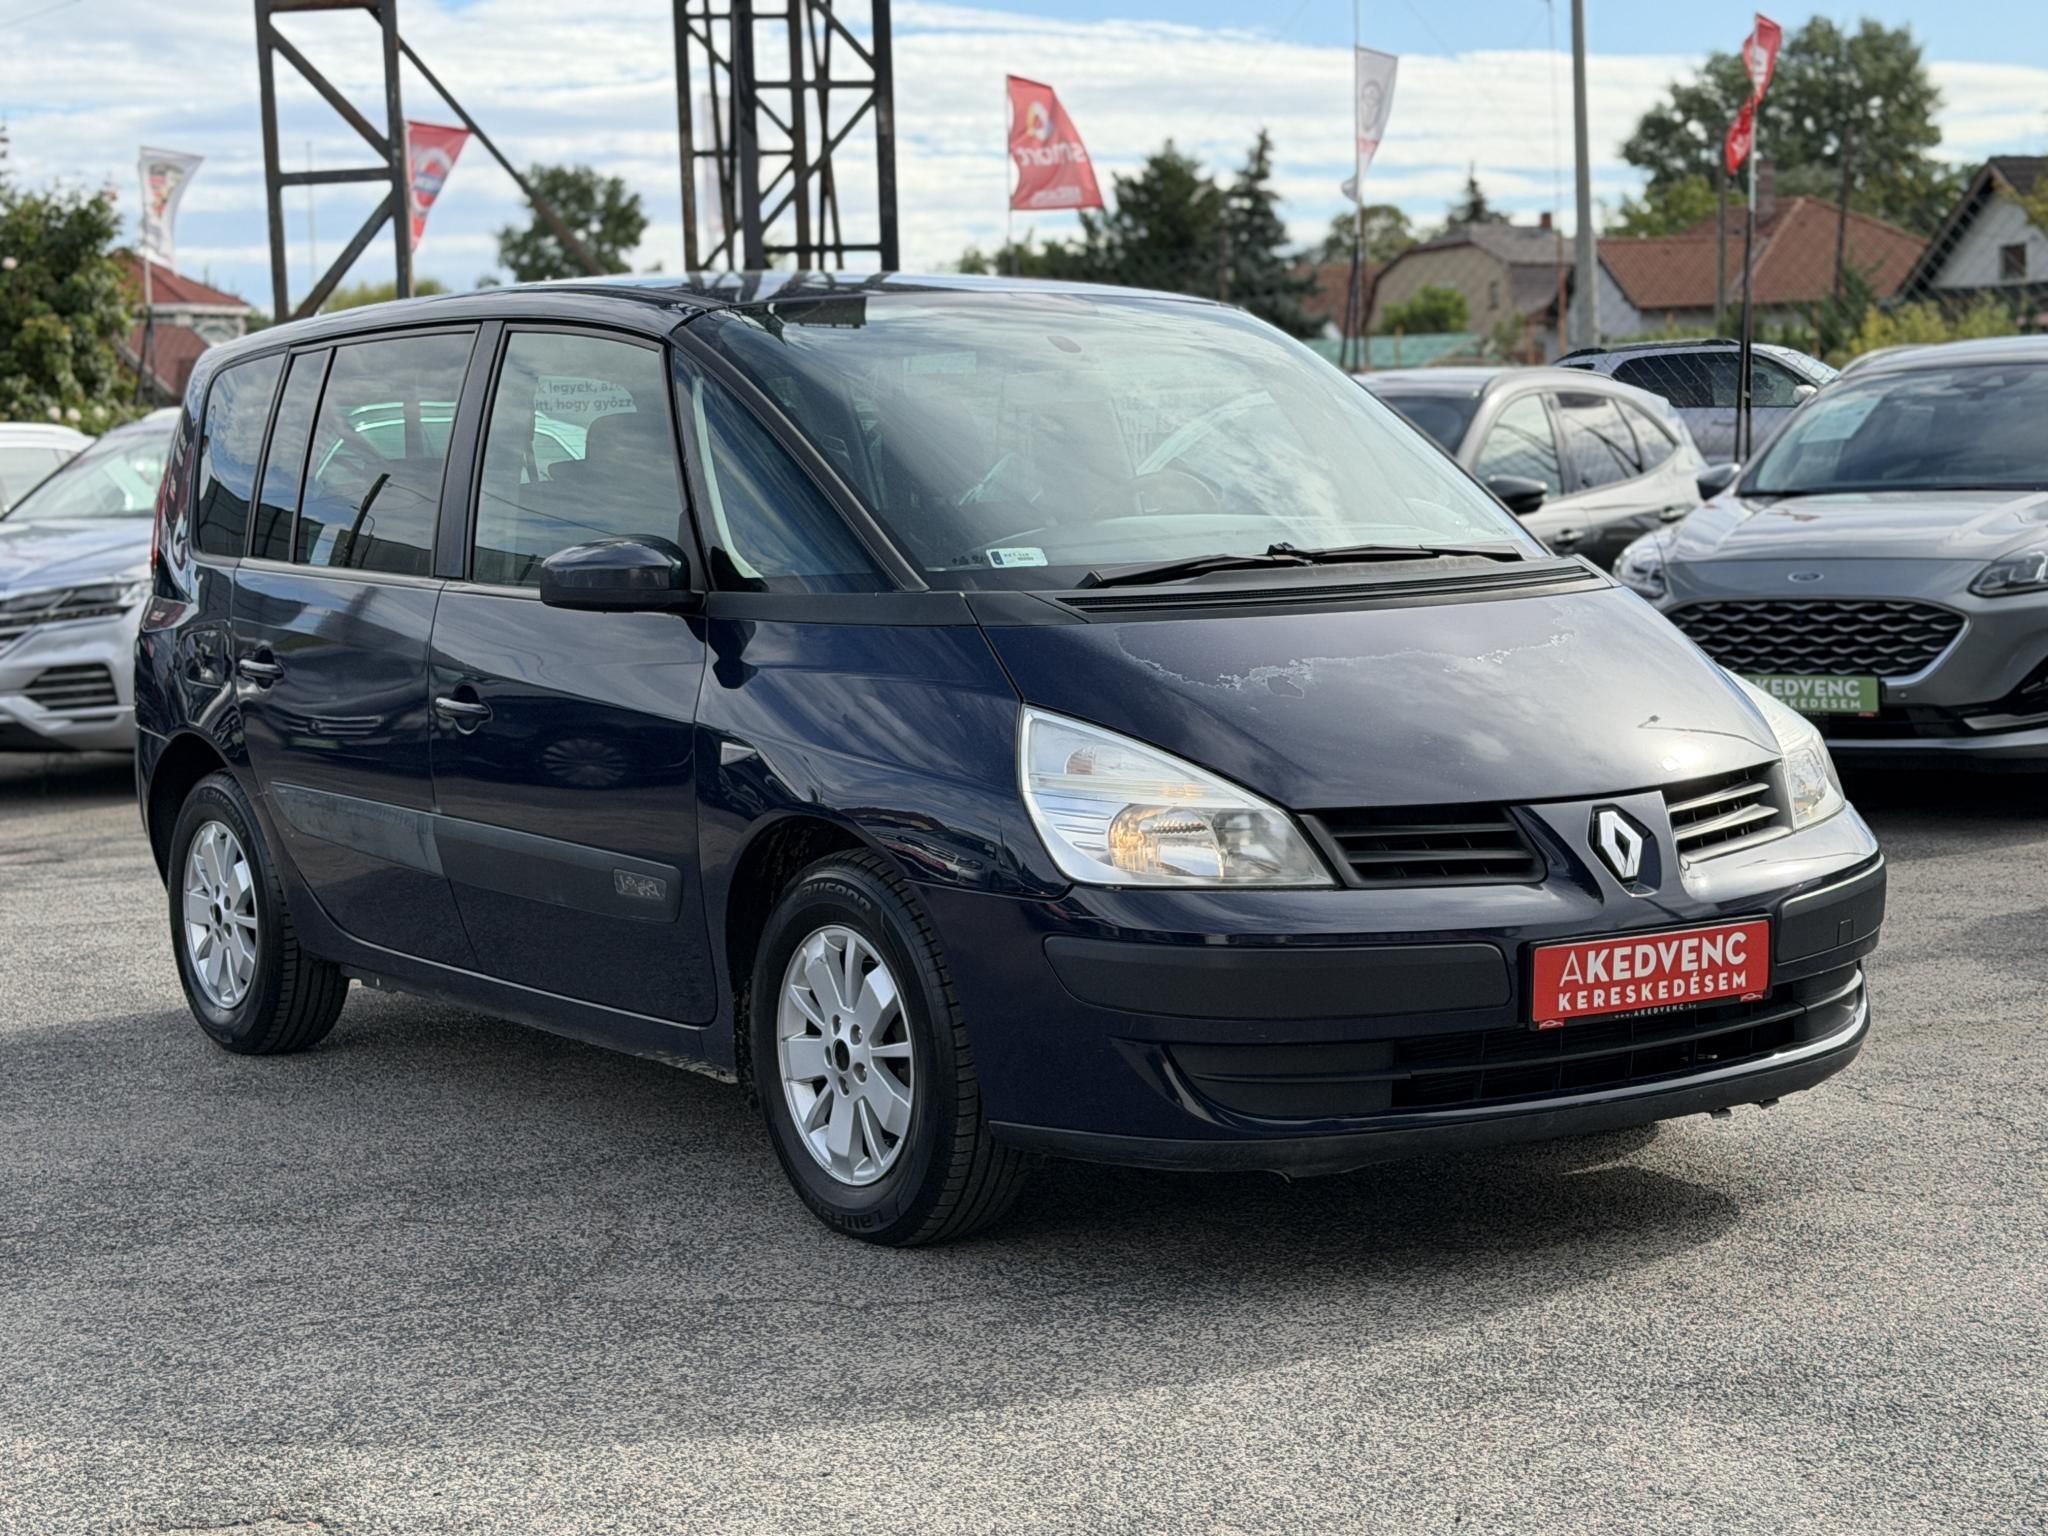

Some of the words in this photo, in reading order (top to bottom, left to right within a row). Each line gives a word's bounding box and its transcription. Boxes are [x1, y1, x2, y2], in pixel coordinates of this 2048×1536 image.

[556, 397, 590, 413] hogy
[1755, 679, 1860, 697] KEDVENC
[1557, 968, 1747, 1012] KERESKEDÉSEM
